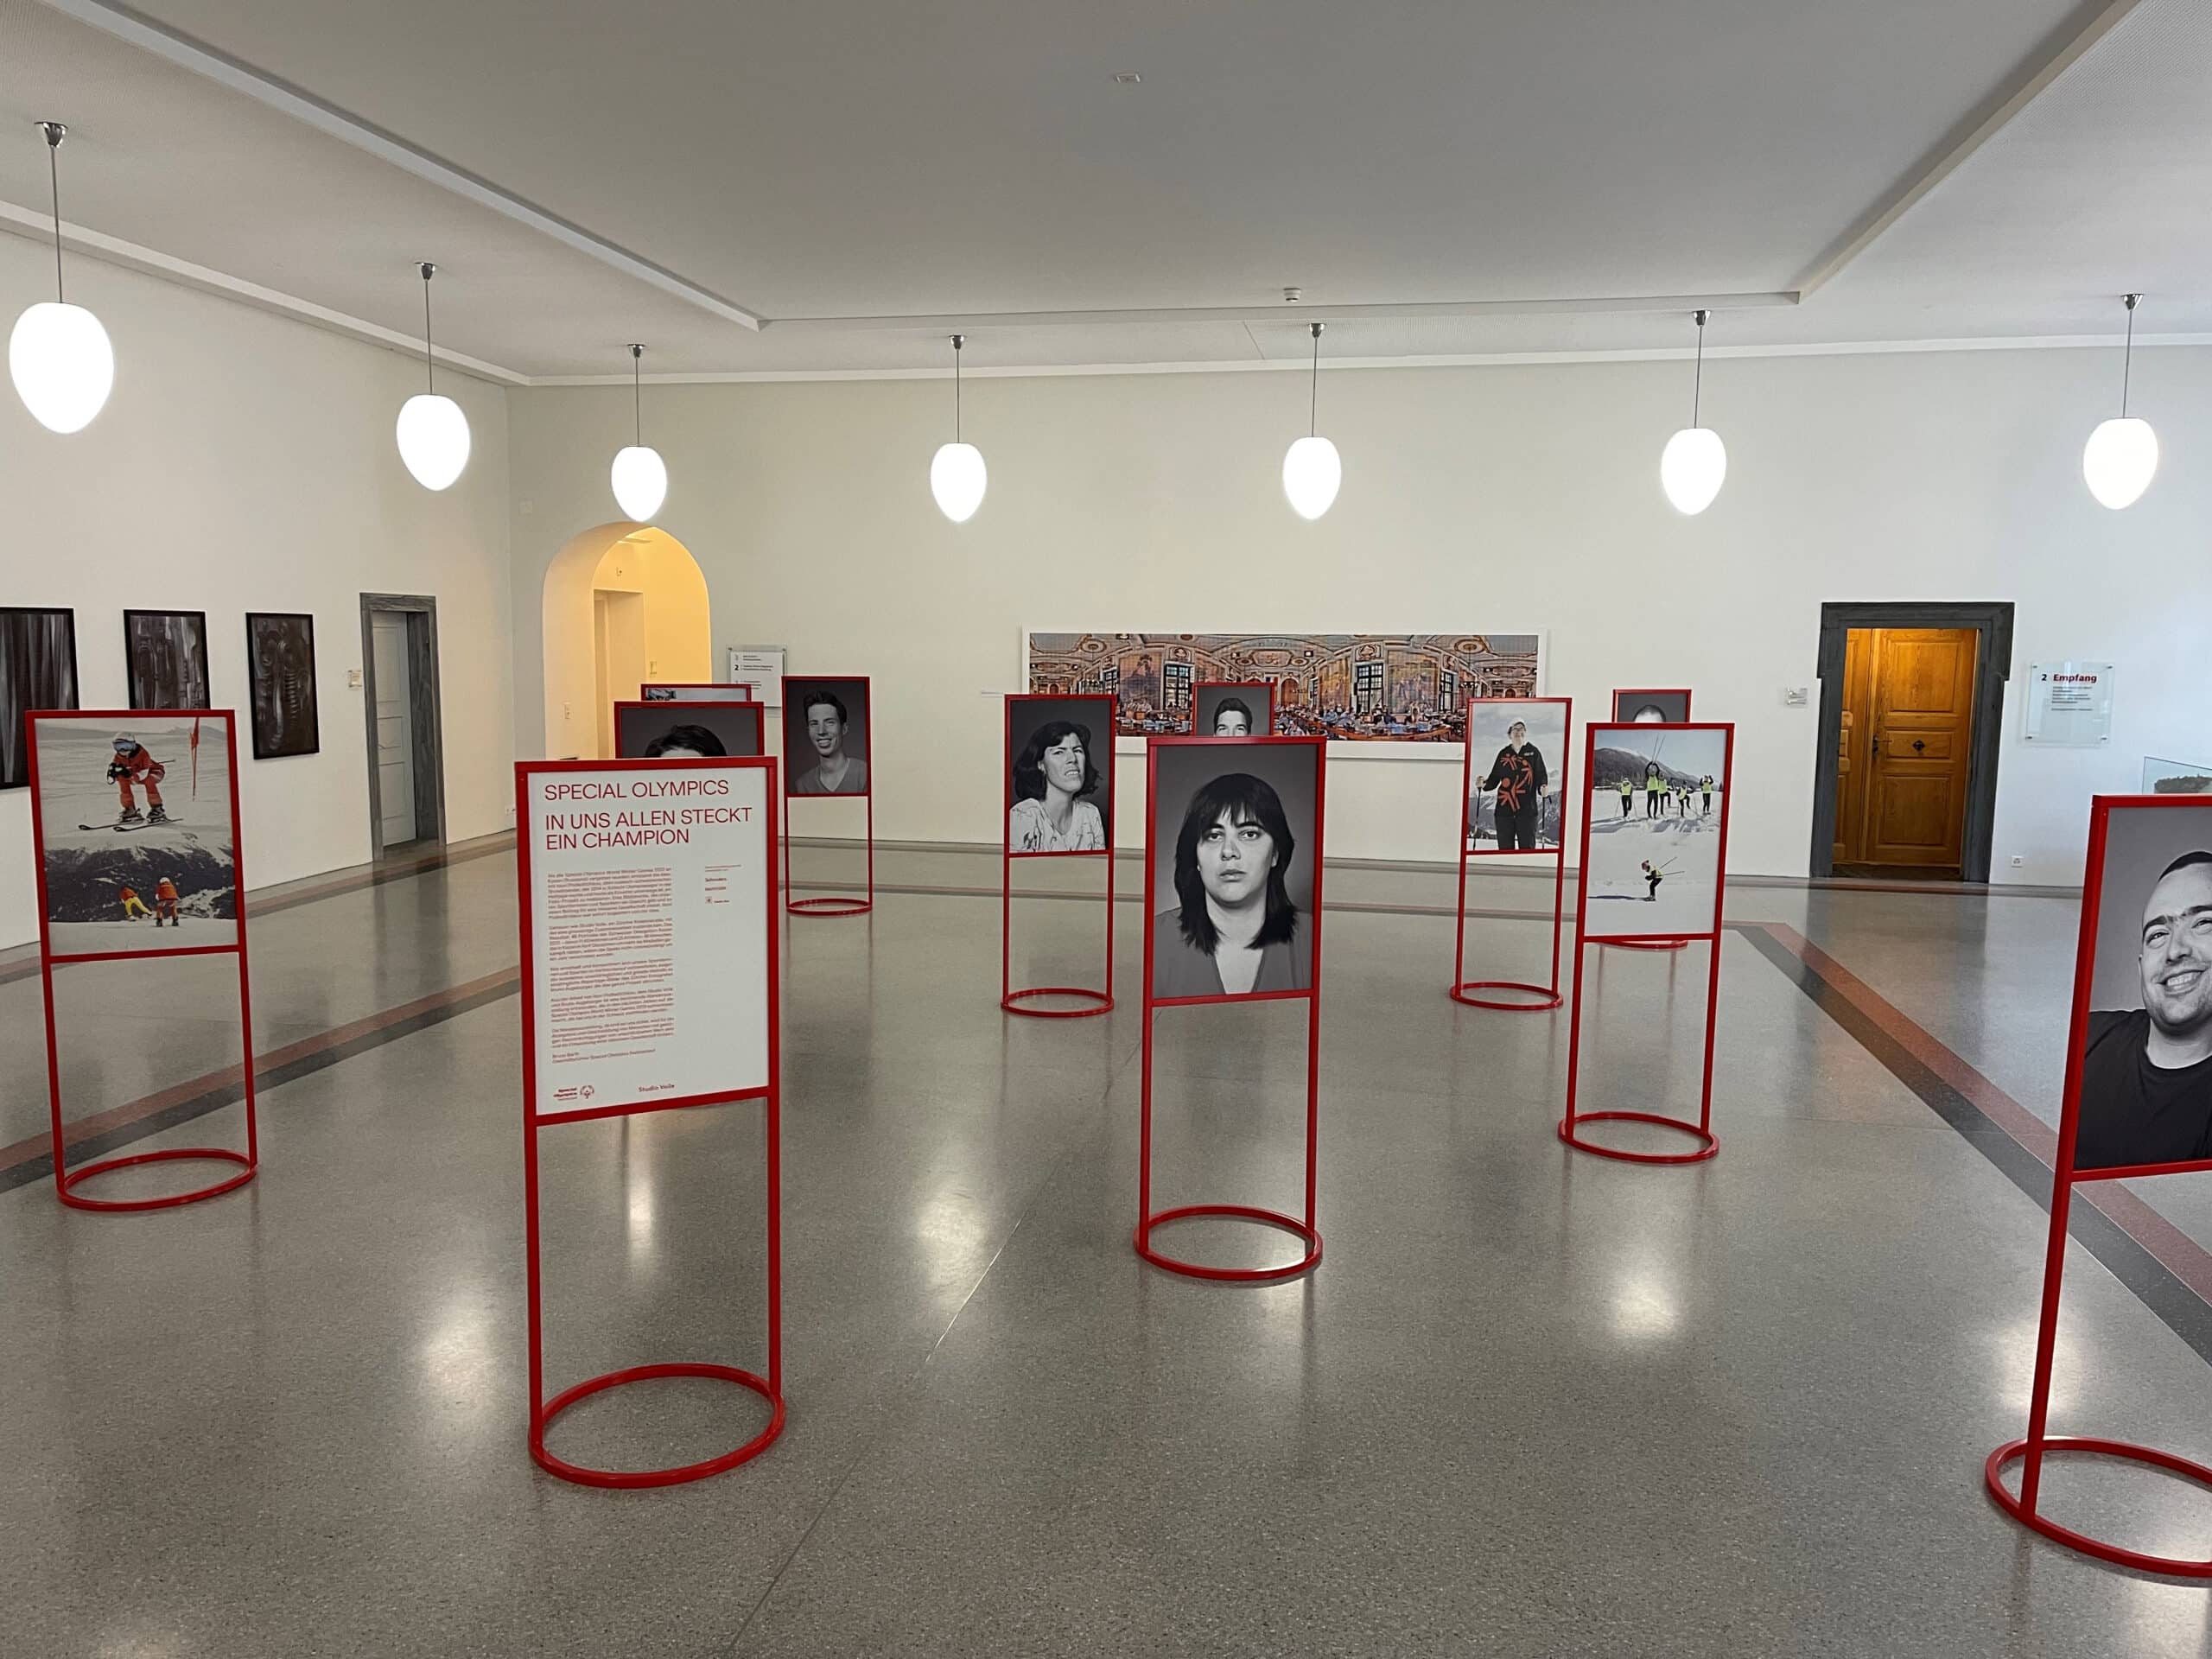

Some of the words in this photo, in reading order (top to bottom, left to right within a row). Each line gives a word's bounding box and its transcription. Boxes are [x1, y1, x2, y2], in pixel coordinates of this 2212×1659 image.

[2053, 674, 2097, 683] Empfang
[545, 783, 626, 800] SPECIAL
[632, 780, 728, 798] OLYMPICS
[546, 815, 563, 830] IN
[571, 813, 610, 829] UNS
[616, 810, 675, 827] ALLEN
[681, 808, 752, 824] STECKT
[547, 834, 576, 849] EIN
[583, 829, 689, 848] CHAMPION
